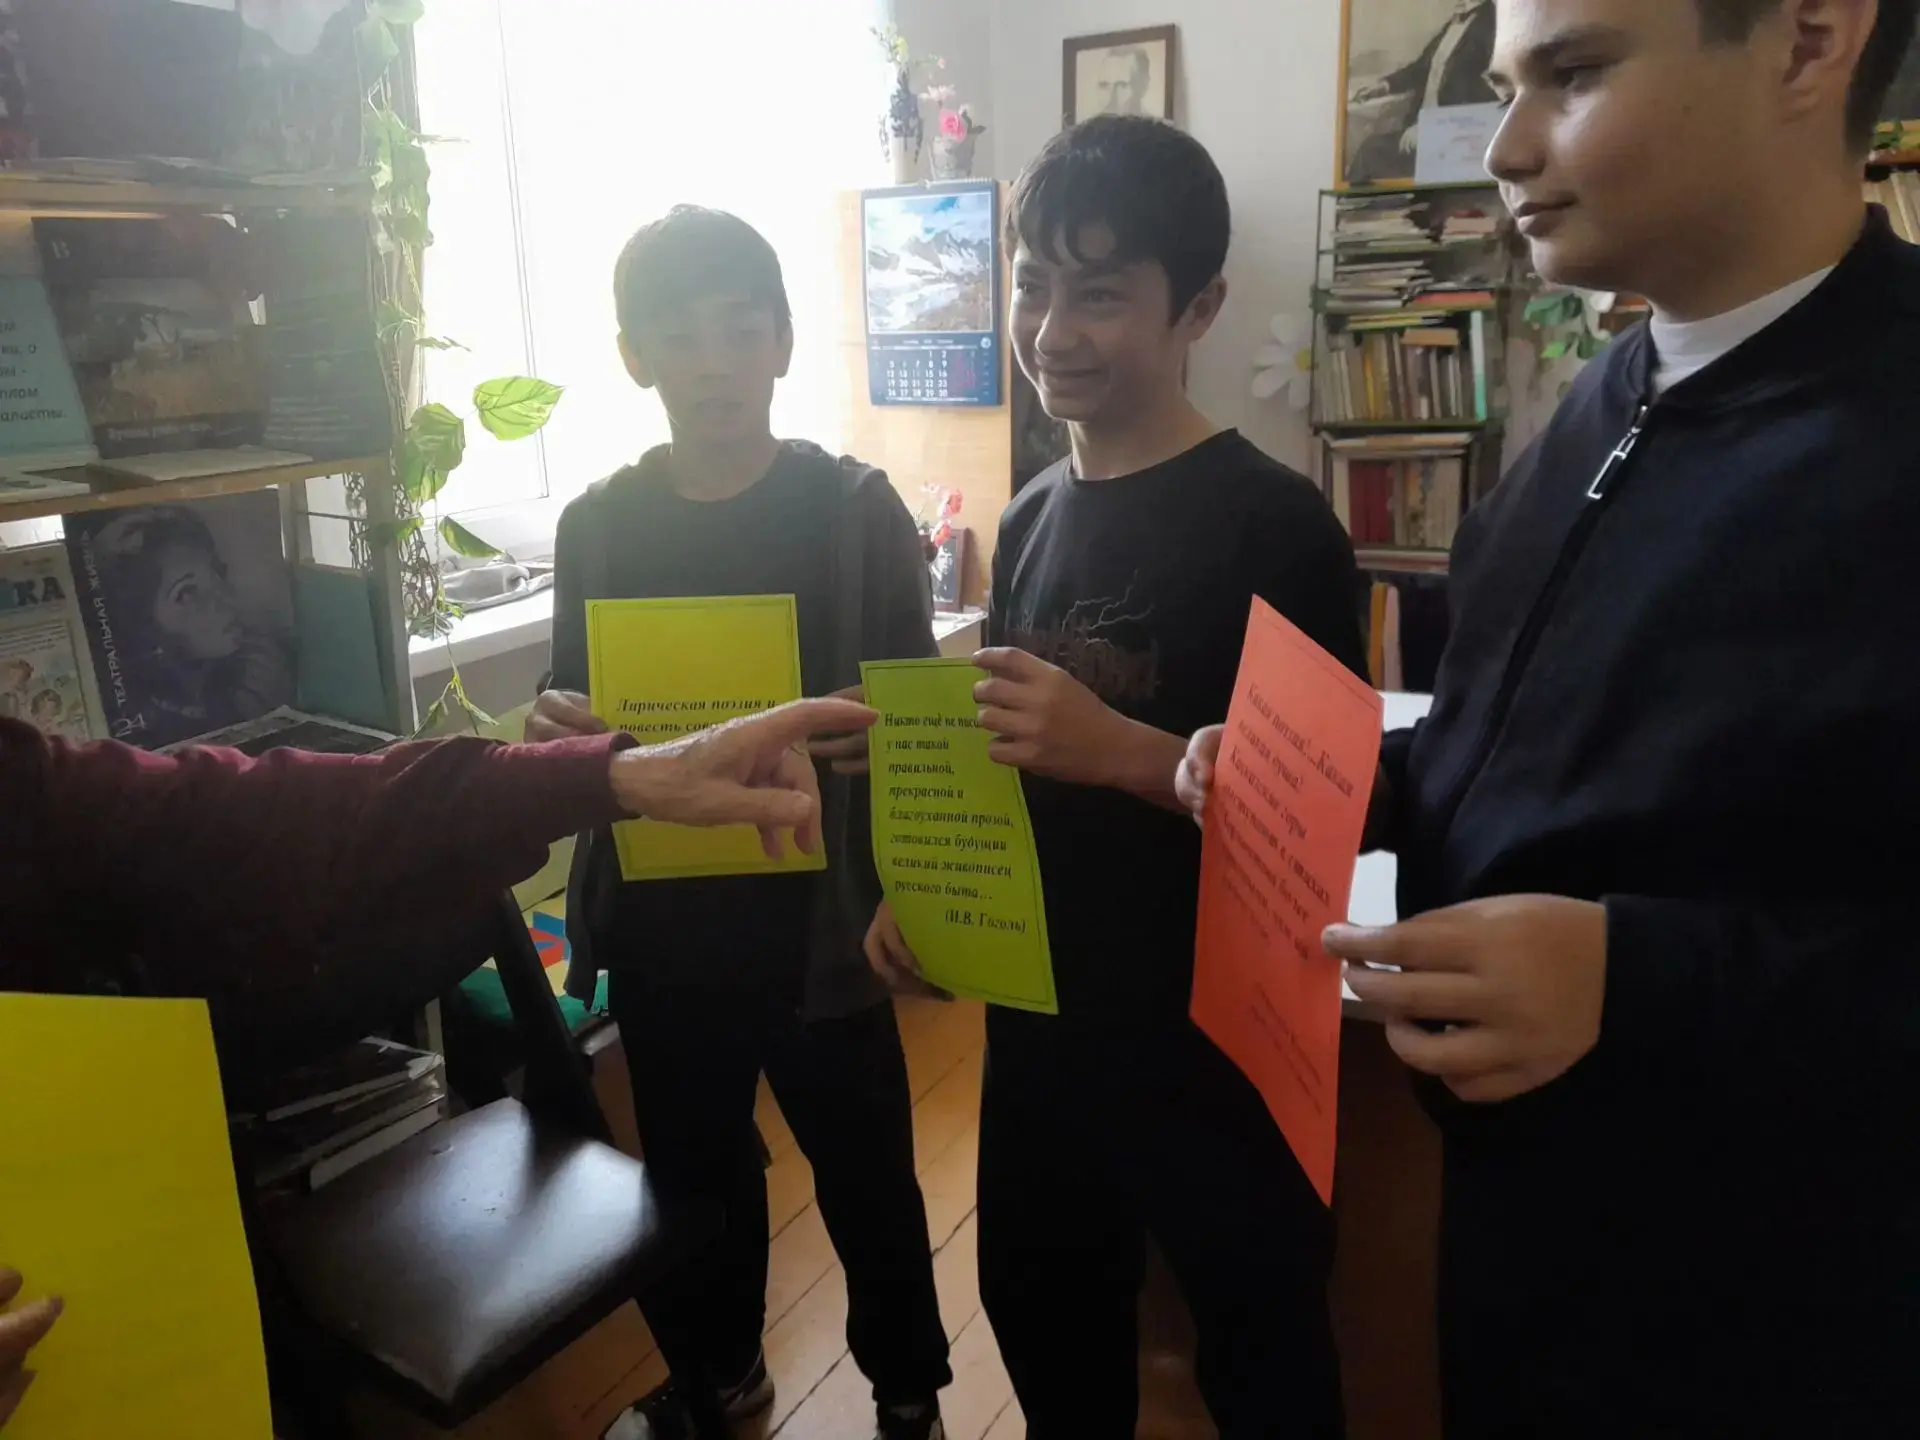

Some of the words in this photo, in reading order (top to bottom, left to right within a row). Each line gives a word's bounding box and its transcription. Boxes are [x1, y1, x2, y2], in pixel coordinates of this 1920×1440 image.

[94, 597, 128, 708] ТЕАТРАЛЬНАЯ
[616, 698, 707, 715] Лирическая
[711, 699, 762, 712] поэзия
[619, 721, 681, 734] повесть
[685, 720, 718, 734] сов
[885, 713, 920, 727] Никто
[945, 717, 956, 728] не
[895, 740, 913, 750] нас
[916, 737, 949, 750] такой
[888, 760, 955, 777] правильной,
[889, 785, 954, 801] прекрасной
[957, 789, 964, 799] и
[971, 812, 1014, 828] прозой,
[889, 833, 951, 848] готовился
[892, 857, 938, 871] великий
[941, 860, 1012, 879] живописец
[895, 881, 941, 895] русского
